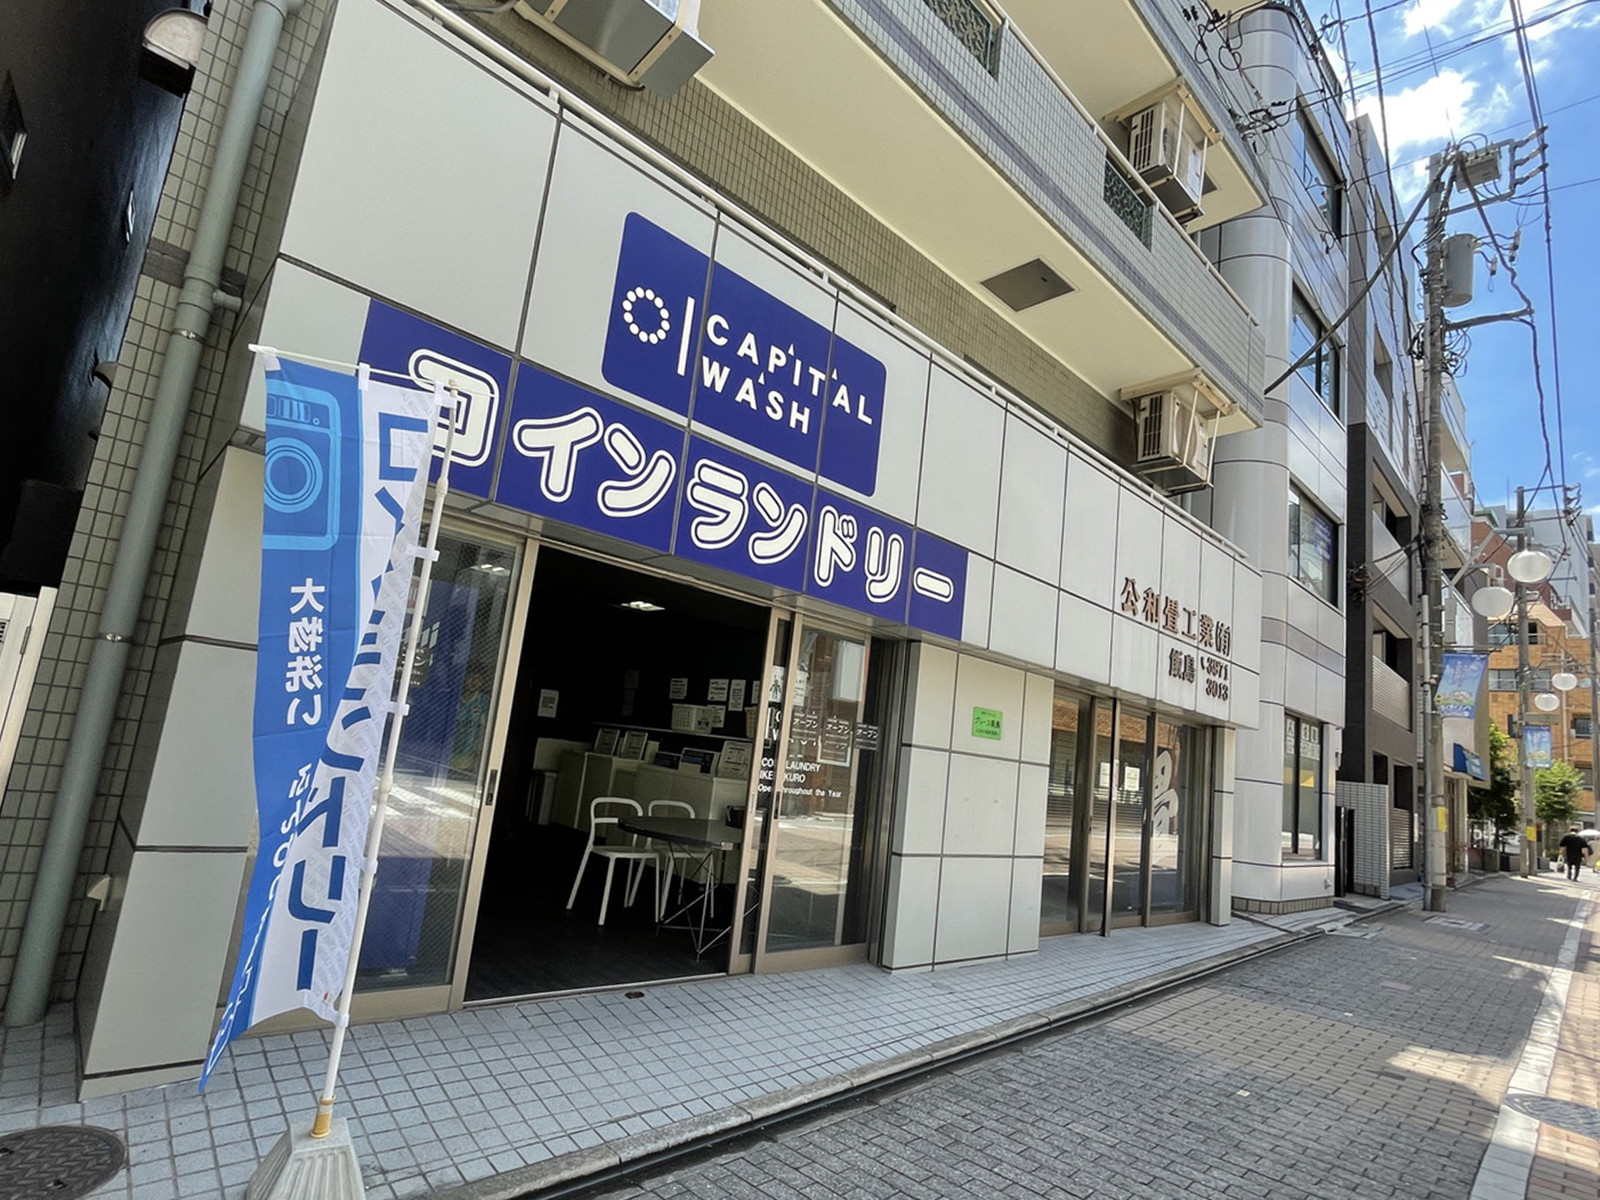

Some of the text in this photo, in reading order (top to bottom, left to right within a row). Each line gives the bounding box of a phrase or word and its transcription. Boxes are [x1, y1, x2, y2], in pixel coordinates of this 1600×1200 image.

[701, 355, 811, 435] WASH
[707, 314, 873, 425] CAPITAL
[408, 348, 954, 604] コインランドリー
[783, 786, 813, 796] hroughout
[815, 788, 826, 797] the
[828, 789, 842, 798] Year
[785, 760, 821, 773] LAUNDRY
